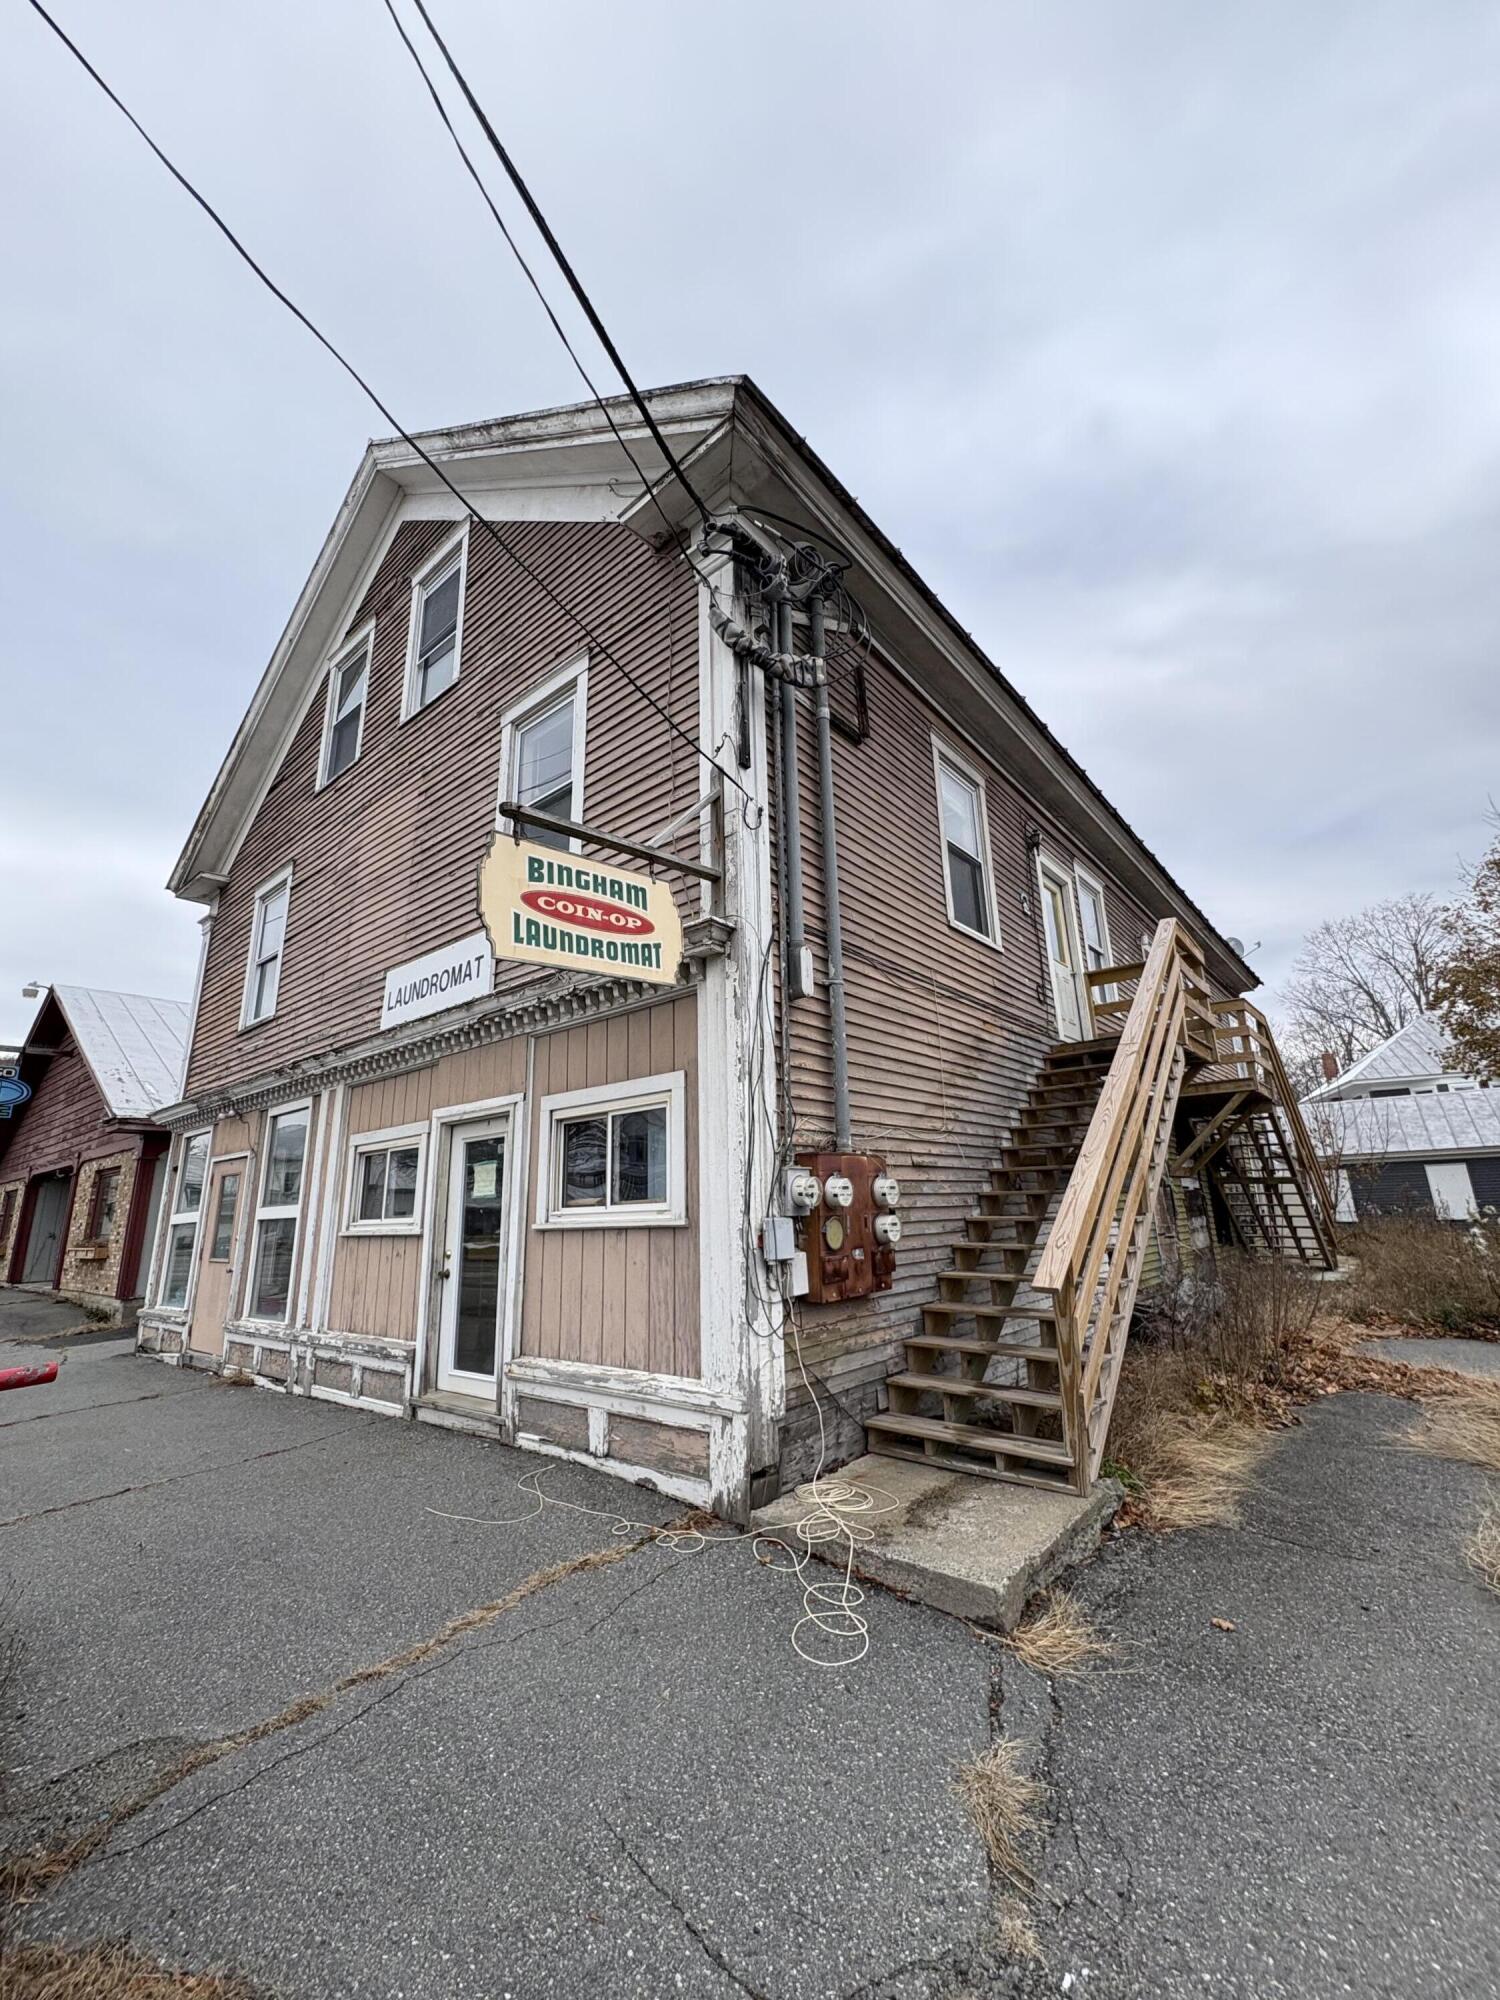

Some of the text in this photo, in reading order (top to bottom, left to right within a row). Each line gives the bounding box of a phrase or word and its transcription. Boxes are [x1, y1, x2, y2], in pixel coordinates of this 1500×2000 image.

[527, 855, 648, 911] BINGHAM
[513, 911, 662, 969] LAUNDROMAT
[537, 896, 642, 929] COIN-OP
[387, 954, 485, 1011] LAUNDROMAT
